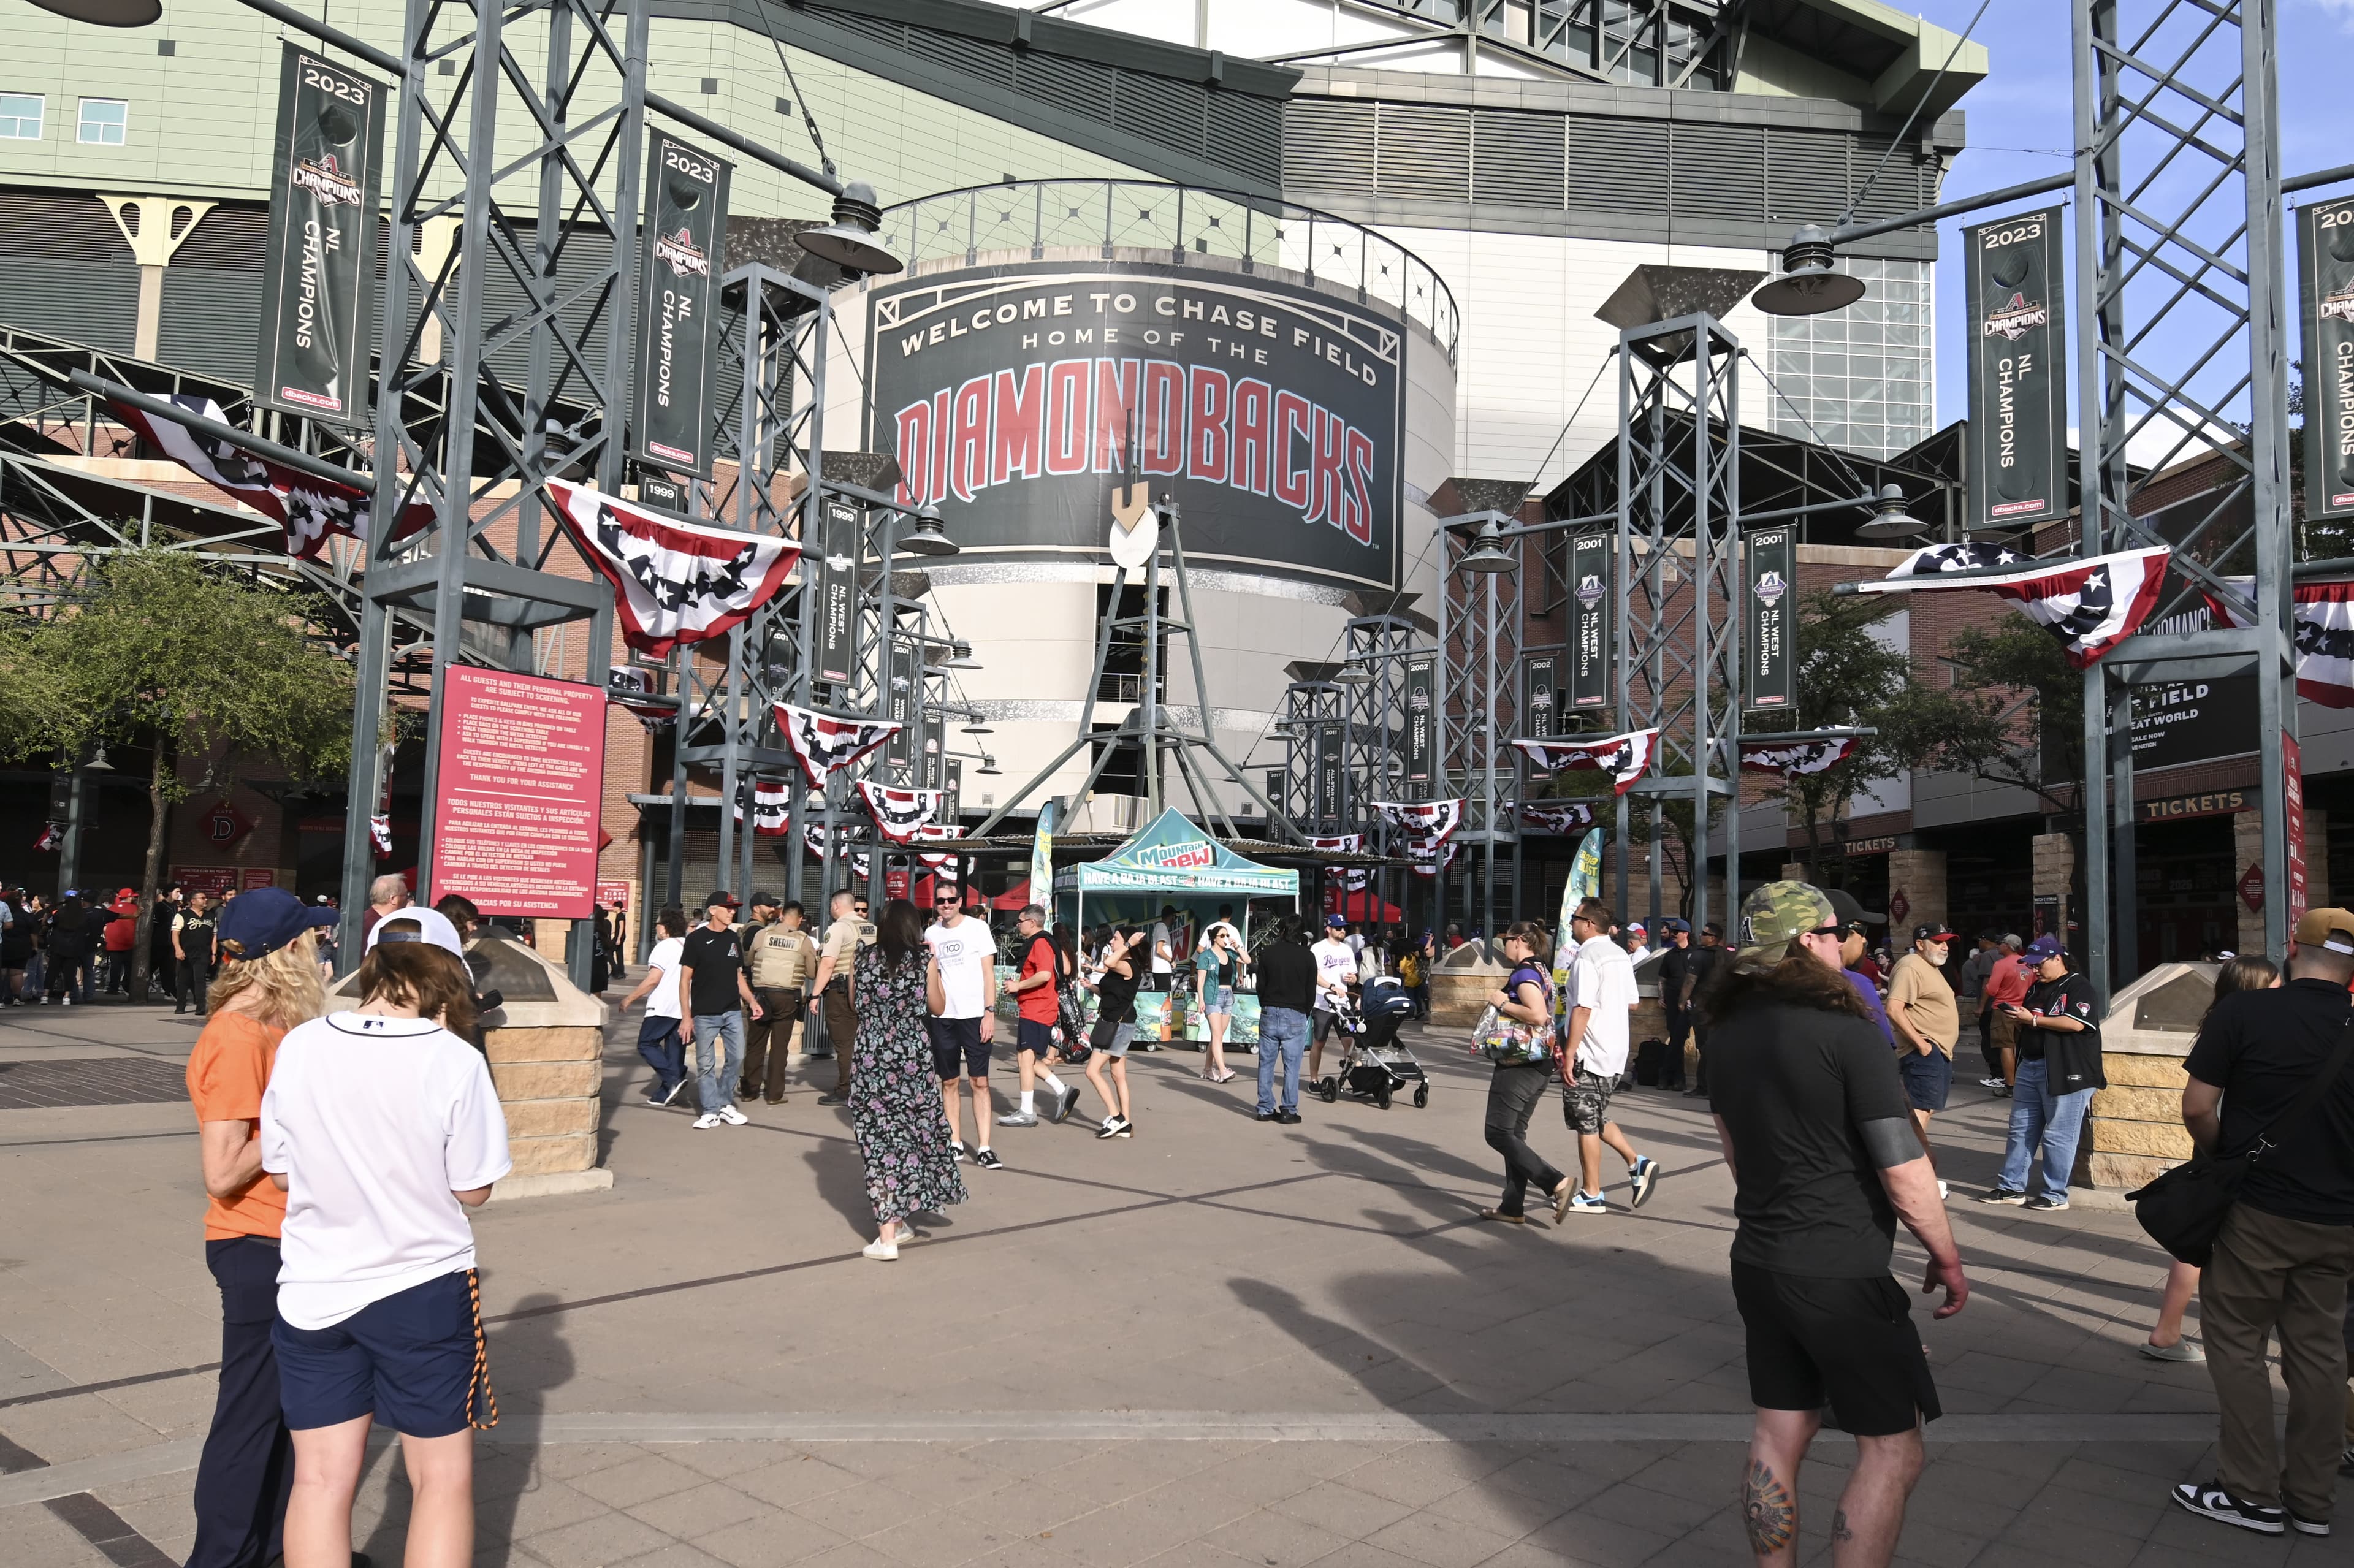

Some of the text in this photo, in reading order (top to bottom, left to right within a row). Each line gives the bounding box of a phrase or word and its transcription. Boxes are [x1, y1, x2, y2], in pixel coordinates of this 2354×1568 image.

[305, 69, 364, 105] 2023
[666, 152, 713, 183] 2023
[294, 167, 360, 205] CHAMPIONS
[2321, 210, 2354, 229] 20
[326, 227, 340, 254] NL
[1985, 224, 2041, 249] 2023
[656, 242, 707, 275] CHAMPIONS
[296, 221, 321, 349] CHAMPIONS
[678, 295, 691, 322] NL
[1984, 310, 2046, 335] CHAMPIONS
[901, 292, 1377, 387] WELCOME TO CHASE FIELD
[1022, 328, 1268, 365] HOME OF THE
[658, 289, 675, 408] CHAMPIONS
[2019, 354, 2032, 381] NL
[284, 390, 338, 408] dbacks.com
[2337, 341, 2354, 456] CHAMPIONS
[1998, 358, 2014, 468] CHAMPIONS
[652, 444, 691, 461] dbacks.com
[894, 357, 1374, 547] DIAMONDBACKS
[649, 484, 675, 499] 1999
[832, 508, 855, 522] 1999
[1995, 502, 2041, 513] dbacks.com
[1577, 539, 1602, 550] 2001
[1756, 535, 1783, 546] 2001
[828, 584, 838, 650] CHAMPIONS
[837, 585, 846, 634] NL WEST
[1771, 609, 1779, 625] NL
[1591, 612, 1598, 627] NL
[894, 646, 909, 655] 2001
[473, 676, 497, 685] GUESTS
[532, 685, 562, 695] PERSONAL
[563, 690, 592, 699] PROPERTY
[498, 688, 524, 697] SUBJECT
[535, 693, 569, 704] SCREENING.
[1420, 715, 1425, 725] NL
[1542, 714, 1547, 725] NL
[2154, 709, 2198, 726] WORLD
[2131, 734, 2147, 743] SALE
[931, 758, 935, 767] NL
[538, 781, 573, 790] ASSISTANCE
[504, 804, 538, 812] VISITANTES
[2147, 792, 2243, 817] TICKETS
[452, 807, 492, 816] PERSONALES
[549, 815, 584, 824] INSPECCIÓN.
[211, 816, 235, 840] D
[1845, 837, 1895, 854] TICKETS
[1580, 850, 1598, 866] Baja
[1084, 872, 1109, 885] HAVE
[1111, 873, 1118, 885] A
[1121, 873, 1146, 885] BAJA
[1148, 875, 1178, 885] BLAST
[1198, 877, 1224, 887] HAVE
[1225, 878, 1232, 887] A
[769, 937, 796, 949] SHERIFF
[946, 943, 960, 953] 100
